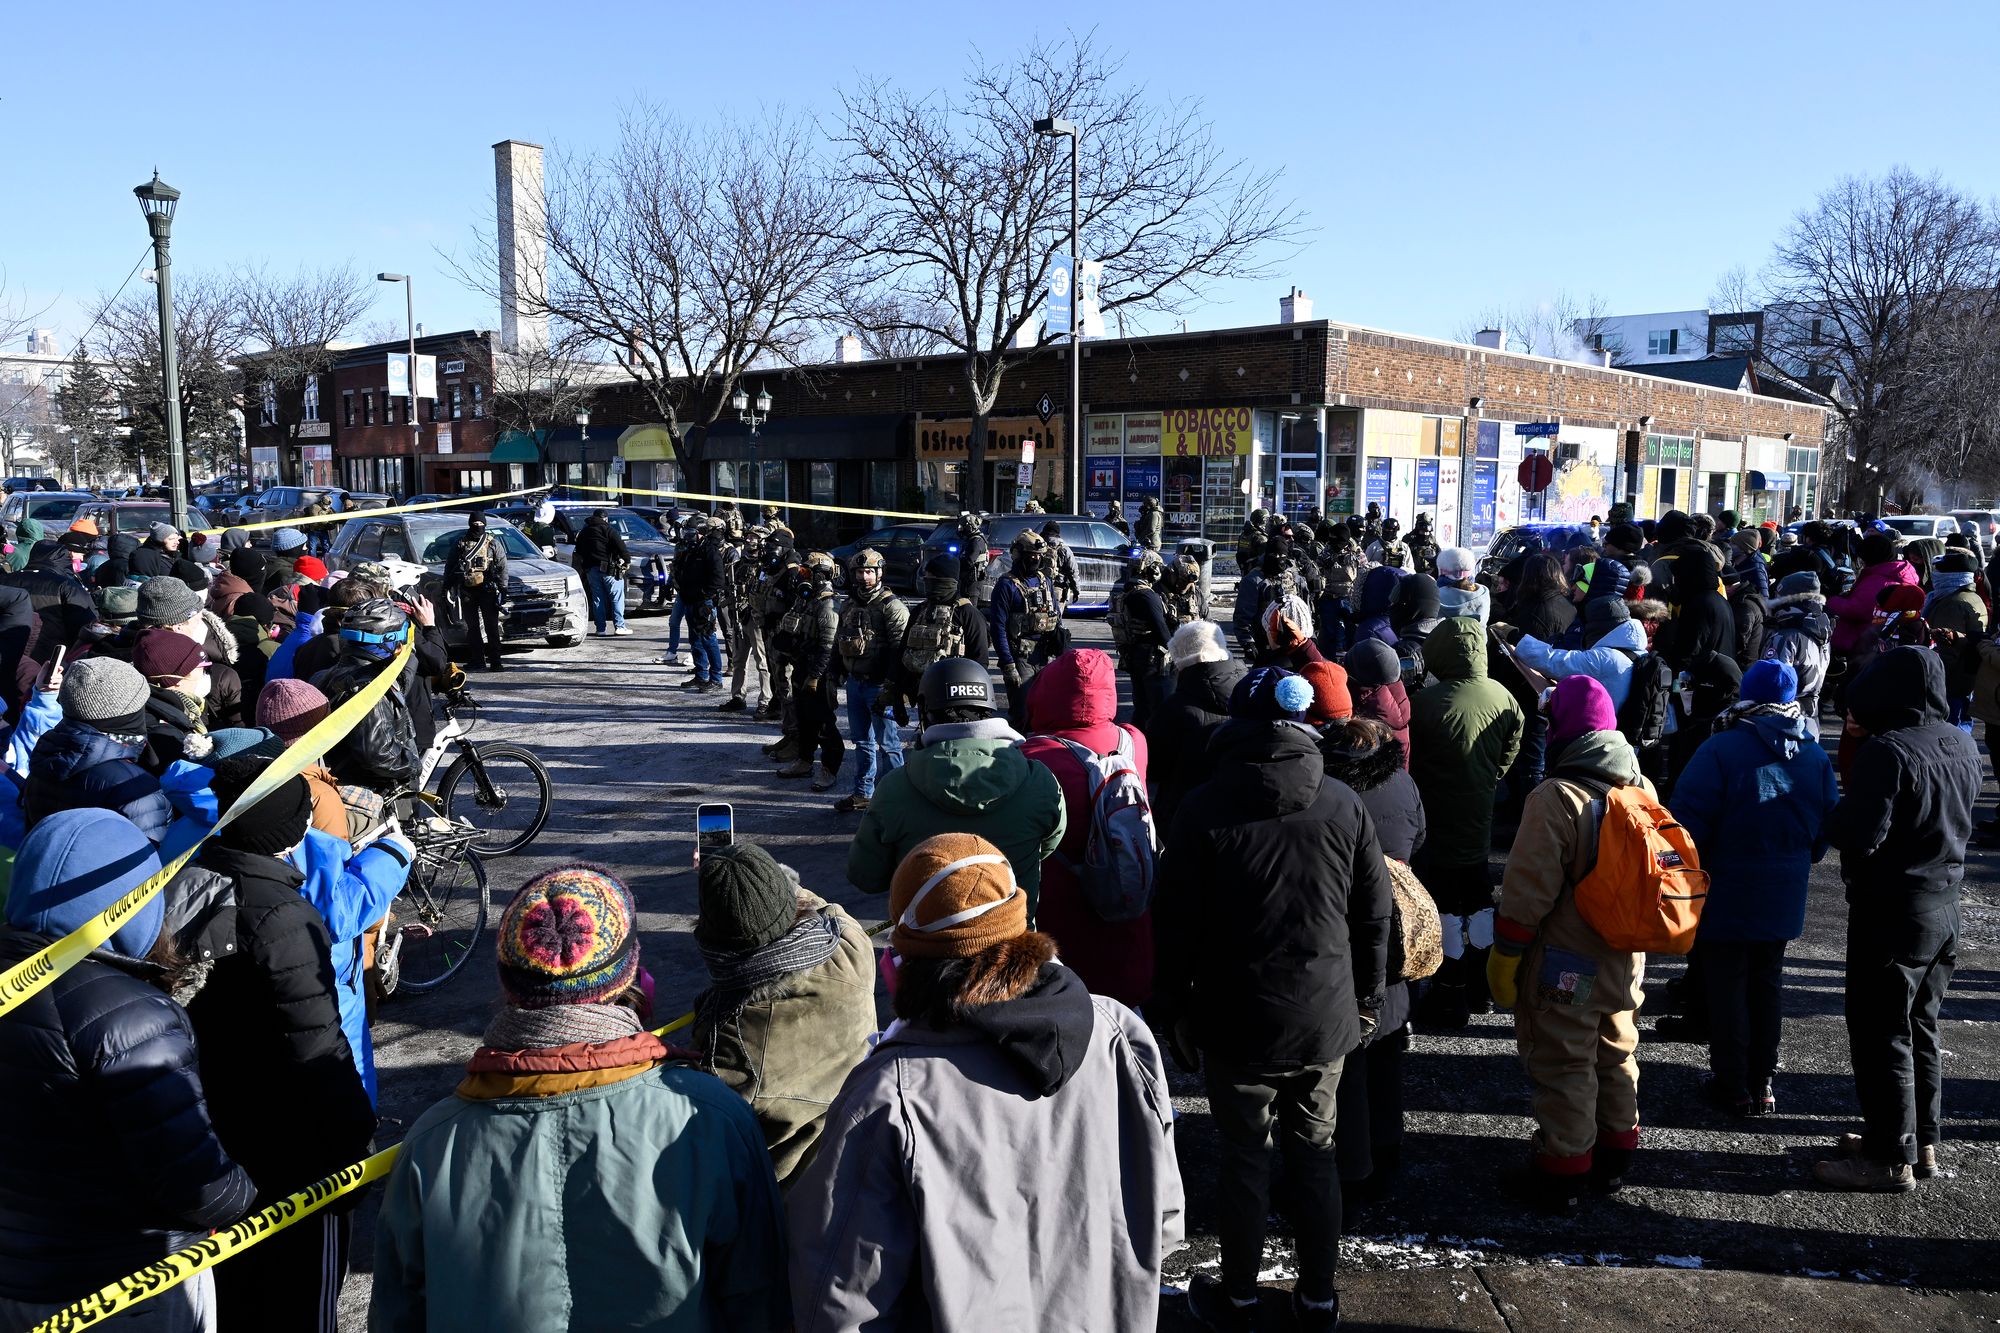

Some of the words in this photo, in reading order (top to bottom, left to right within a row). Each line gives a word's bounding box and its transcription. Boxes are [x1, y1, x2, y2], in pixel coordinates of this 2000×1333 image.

[1042, 399, 1049, 413] 8
[1163, 408, 1250, 433] TOBACCO
[1516, 425, 1542, 433] Nicollet
[1176, 433, 1188, 456] &
[1198, 431, 1236, 456] MAS
[1170, 513, 1196, 523] VAPOR
[1205, 508, 1234, 519] GLASS
[950, 685, 985, 696] PRESS
